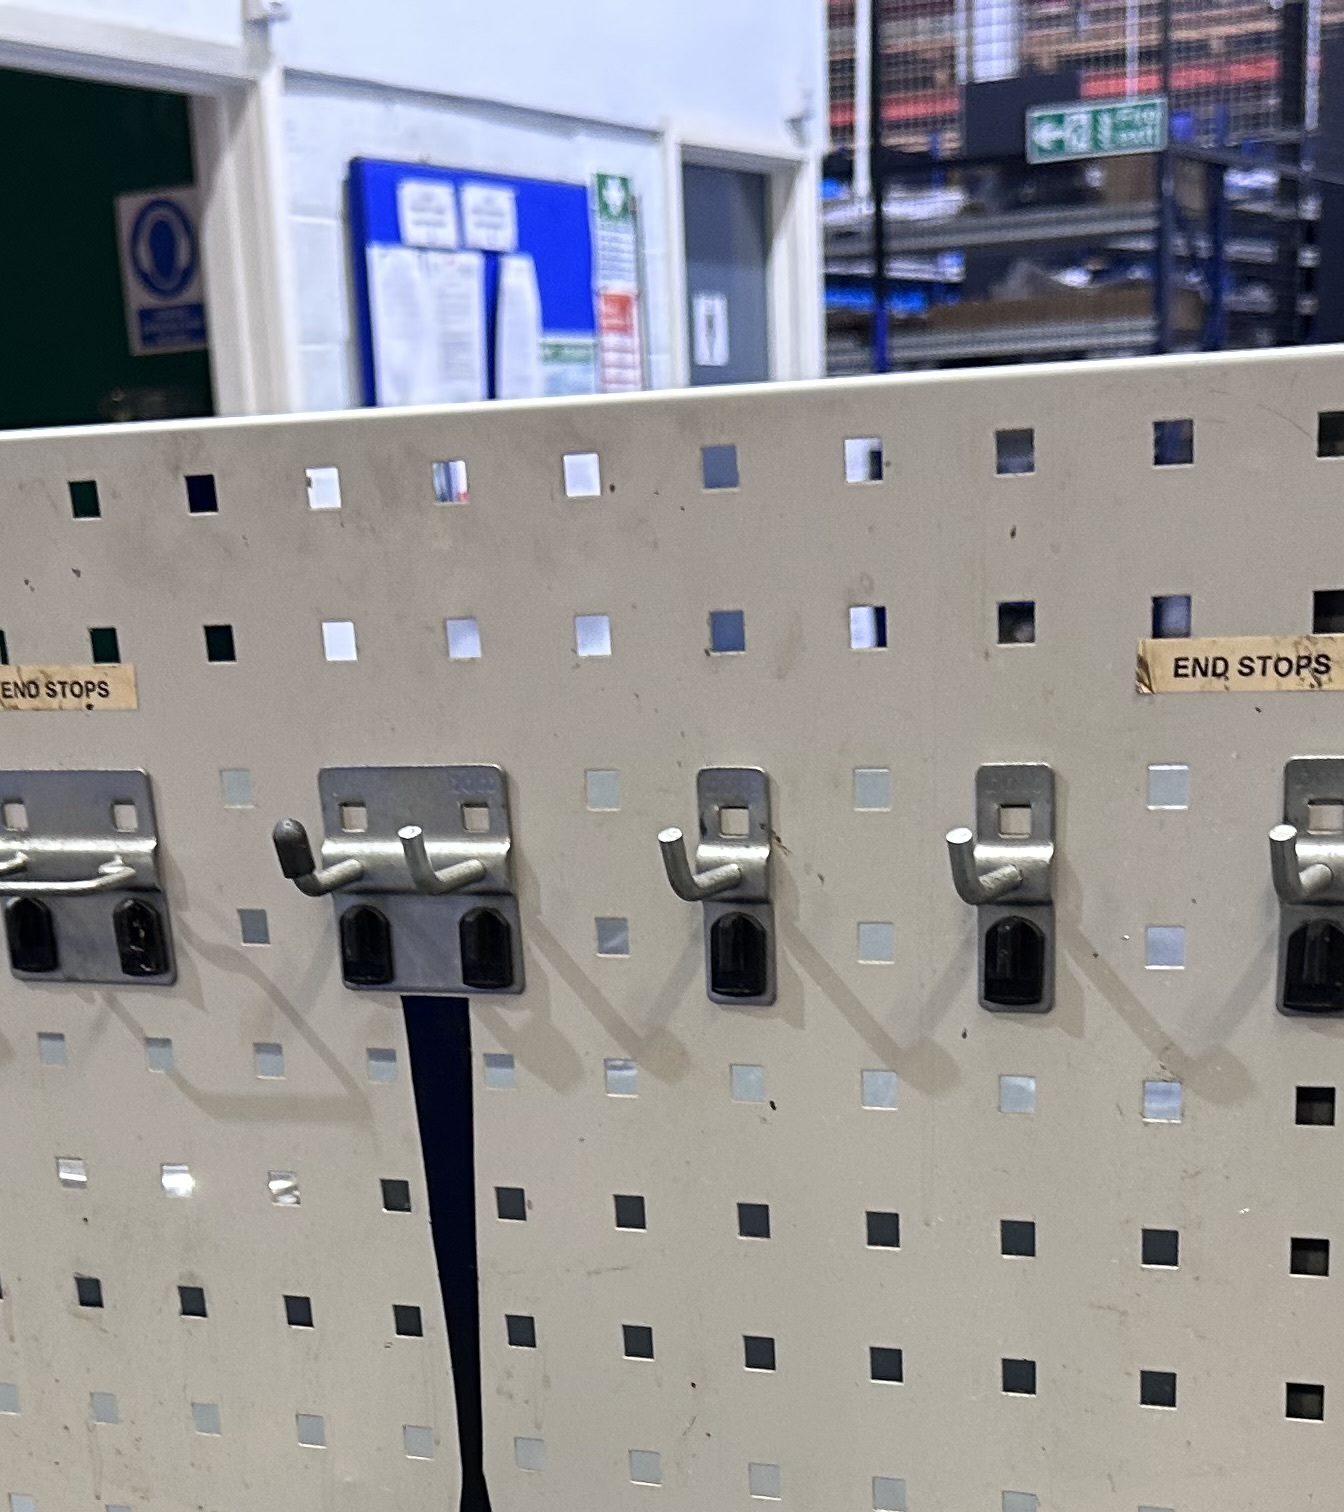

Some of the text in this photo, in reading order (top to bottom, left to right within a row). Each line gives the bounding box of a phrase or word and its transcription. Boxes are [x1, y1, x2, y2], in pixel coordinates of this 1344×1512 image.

[1173, 654, 1332, 678] END STOPS
[0, 680, 110, 699] END STOPS
